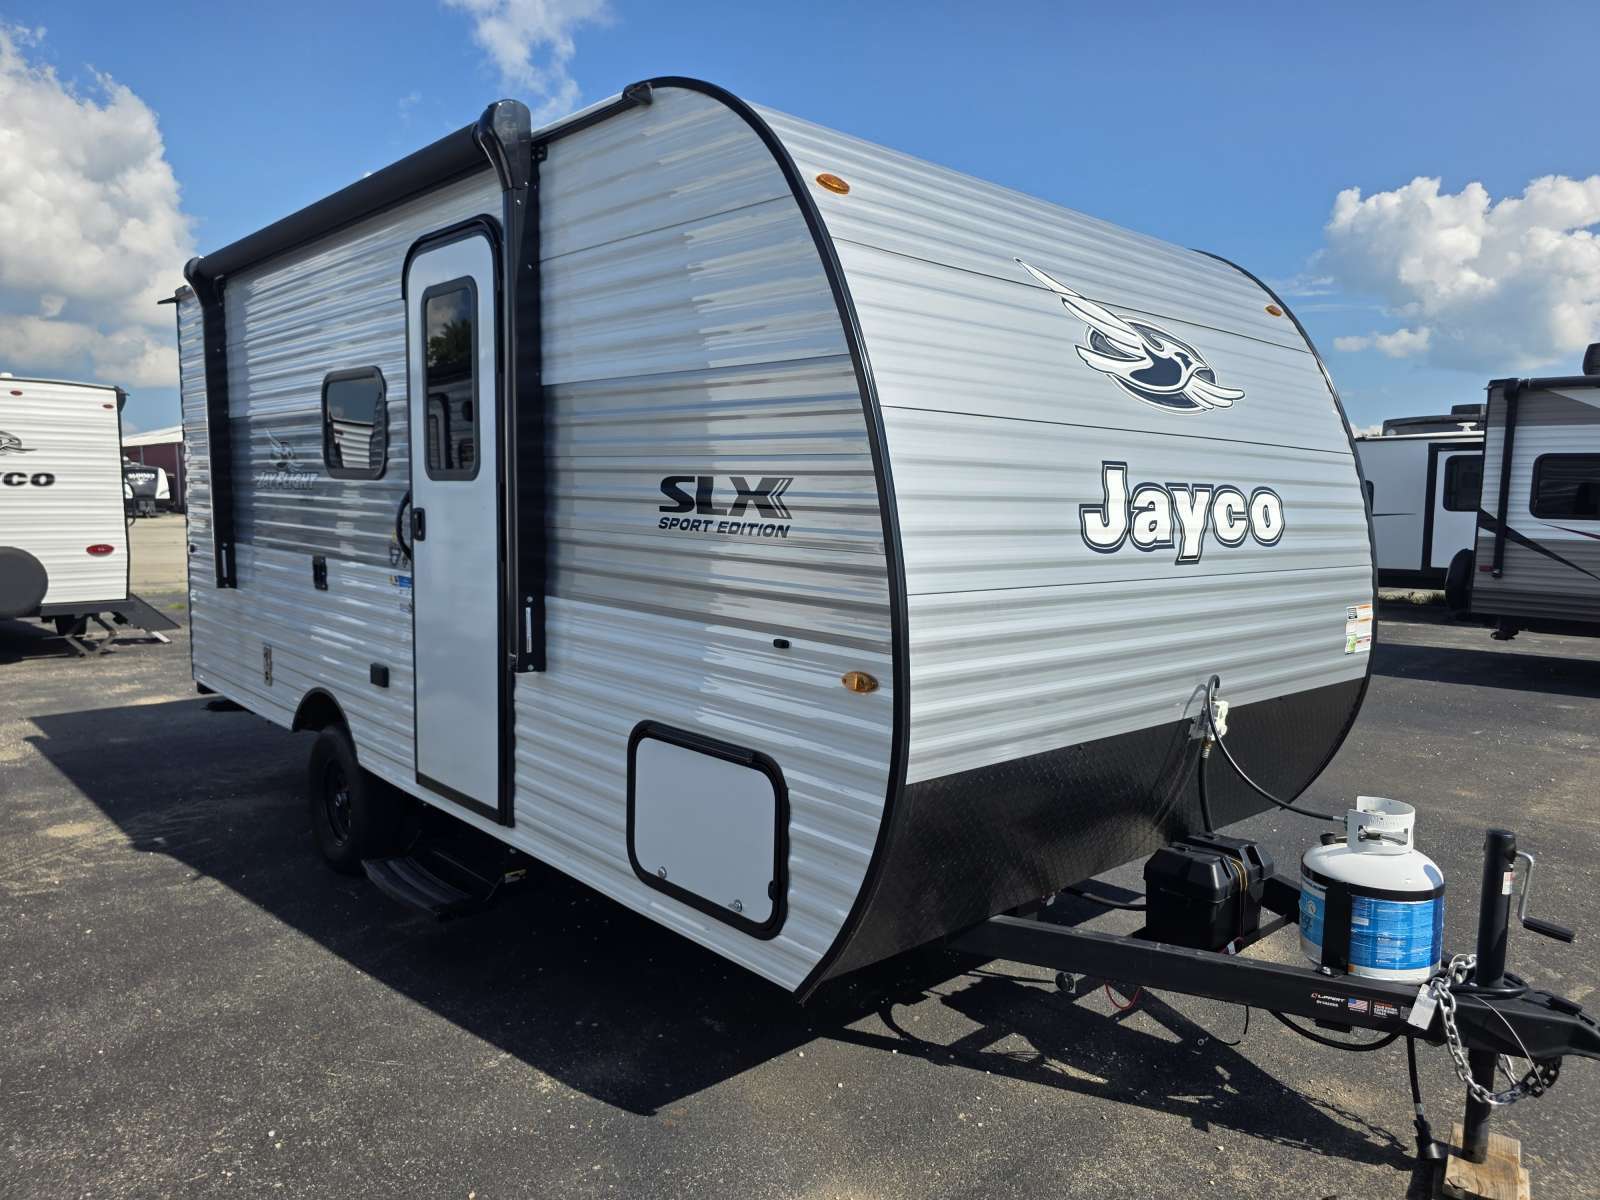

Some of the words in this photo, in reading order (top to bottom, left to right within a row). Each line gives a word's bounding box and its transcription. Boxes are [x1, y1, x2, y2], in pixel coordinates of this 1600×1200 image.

[659, 476, 793, 519] SLX
[1079, 461, 1285, 565] Jayco
[658, 517, 713, 532] SPORT
[717, 521, 790, 538] EDITION
